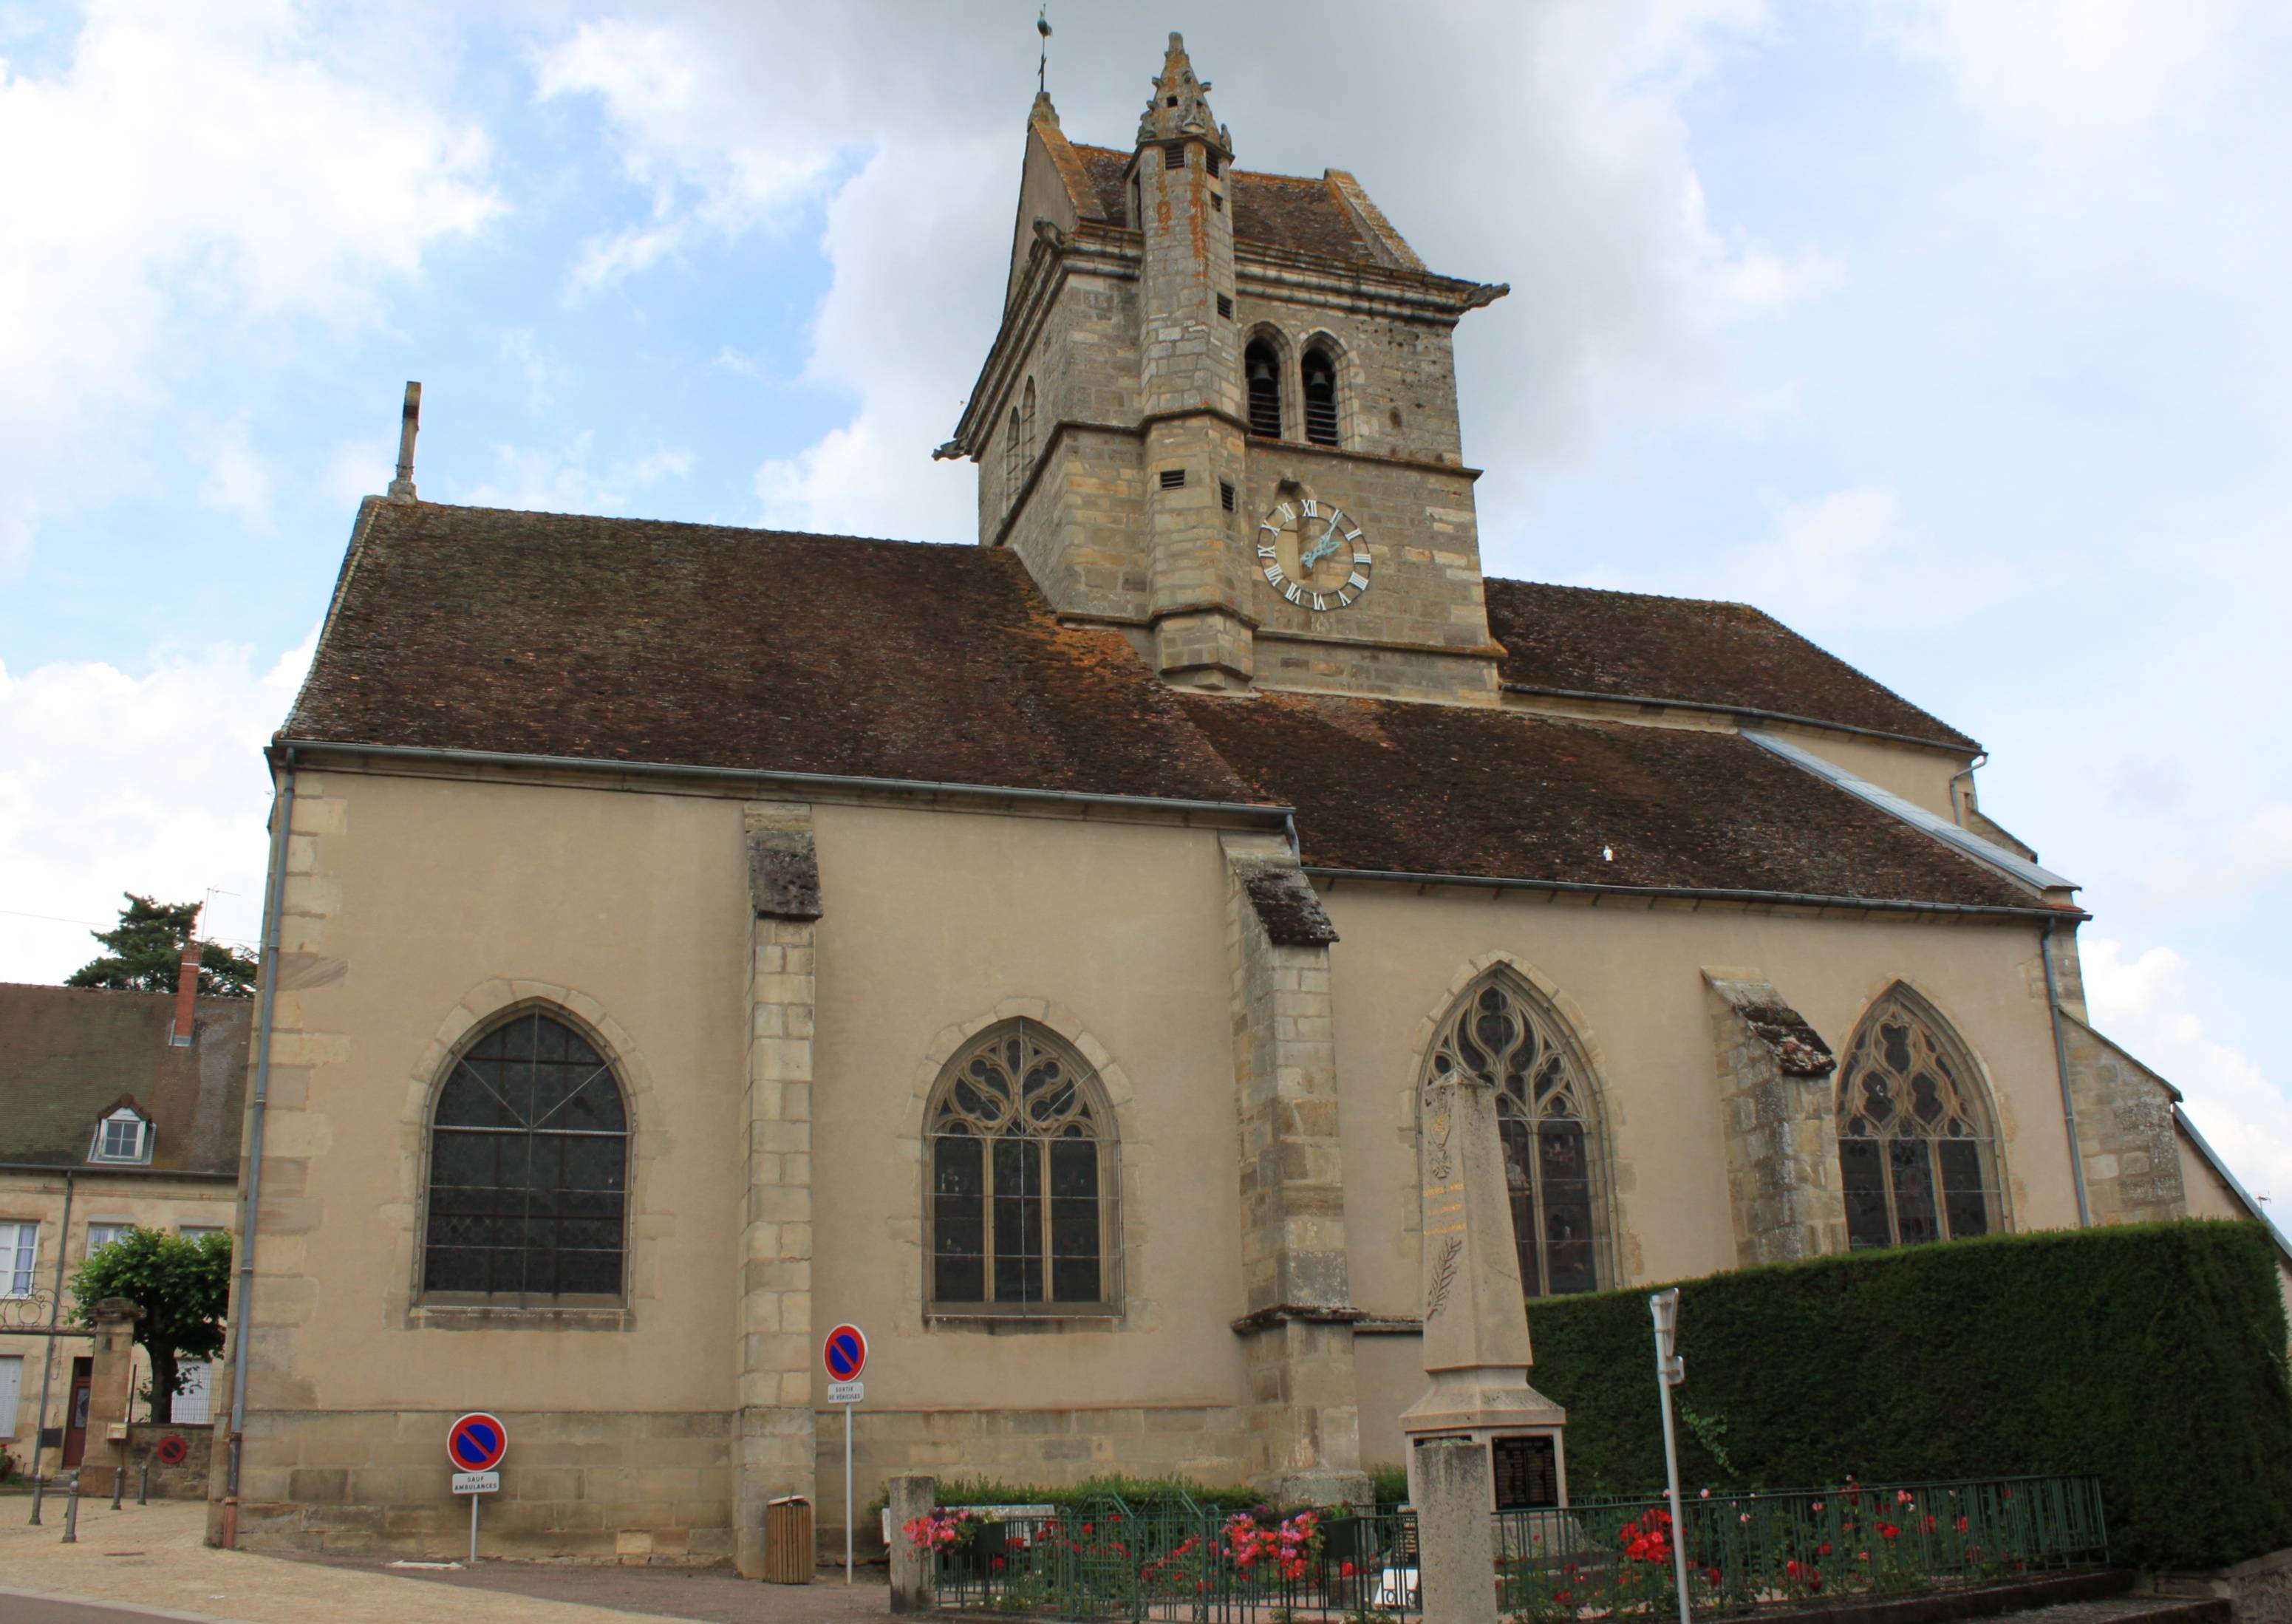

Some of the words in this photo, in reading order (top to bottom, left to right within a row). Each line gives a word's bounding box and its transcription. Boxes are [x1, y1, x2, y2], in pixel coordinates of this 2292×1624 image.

[1278, 502, 1296, 522] XI
[1301, 499, 1318, 517] XII
[1261, 519, 1280, 536] X
[1345, 528, 1362, 541] II
[1354, 553, 1371, 564] III
[1264, 563, 1284, 587] VIII
[1348, 571, 1368, 590] IIII
[1285, 582, 1301, 605] VII
[1312, 592, 1326, 610] VI
[1337, 590, 1351, 606] V
